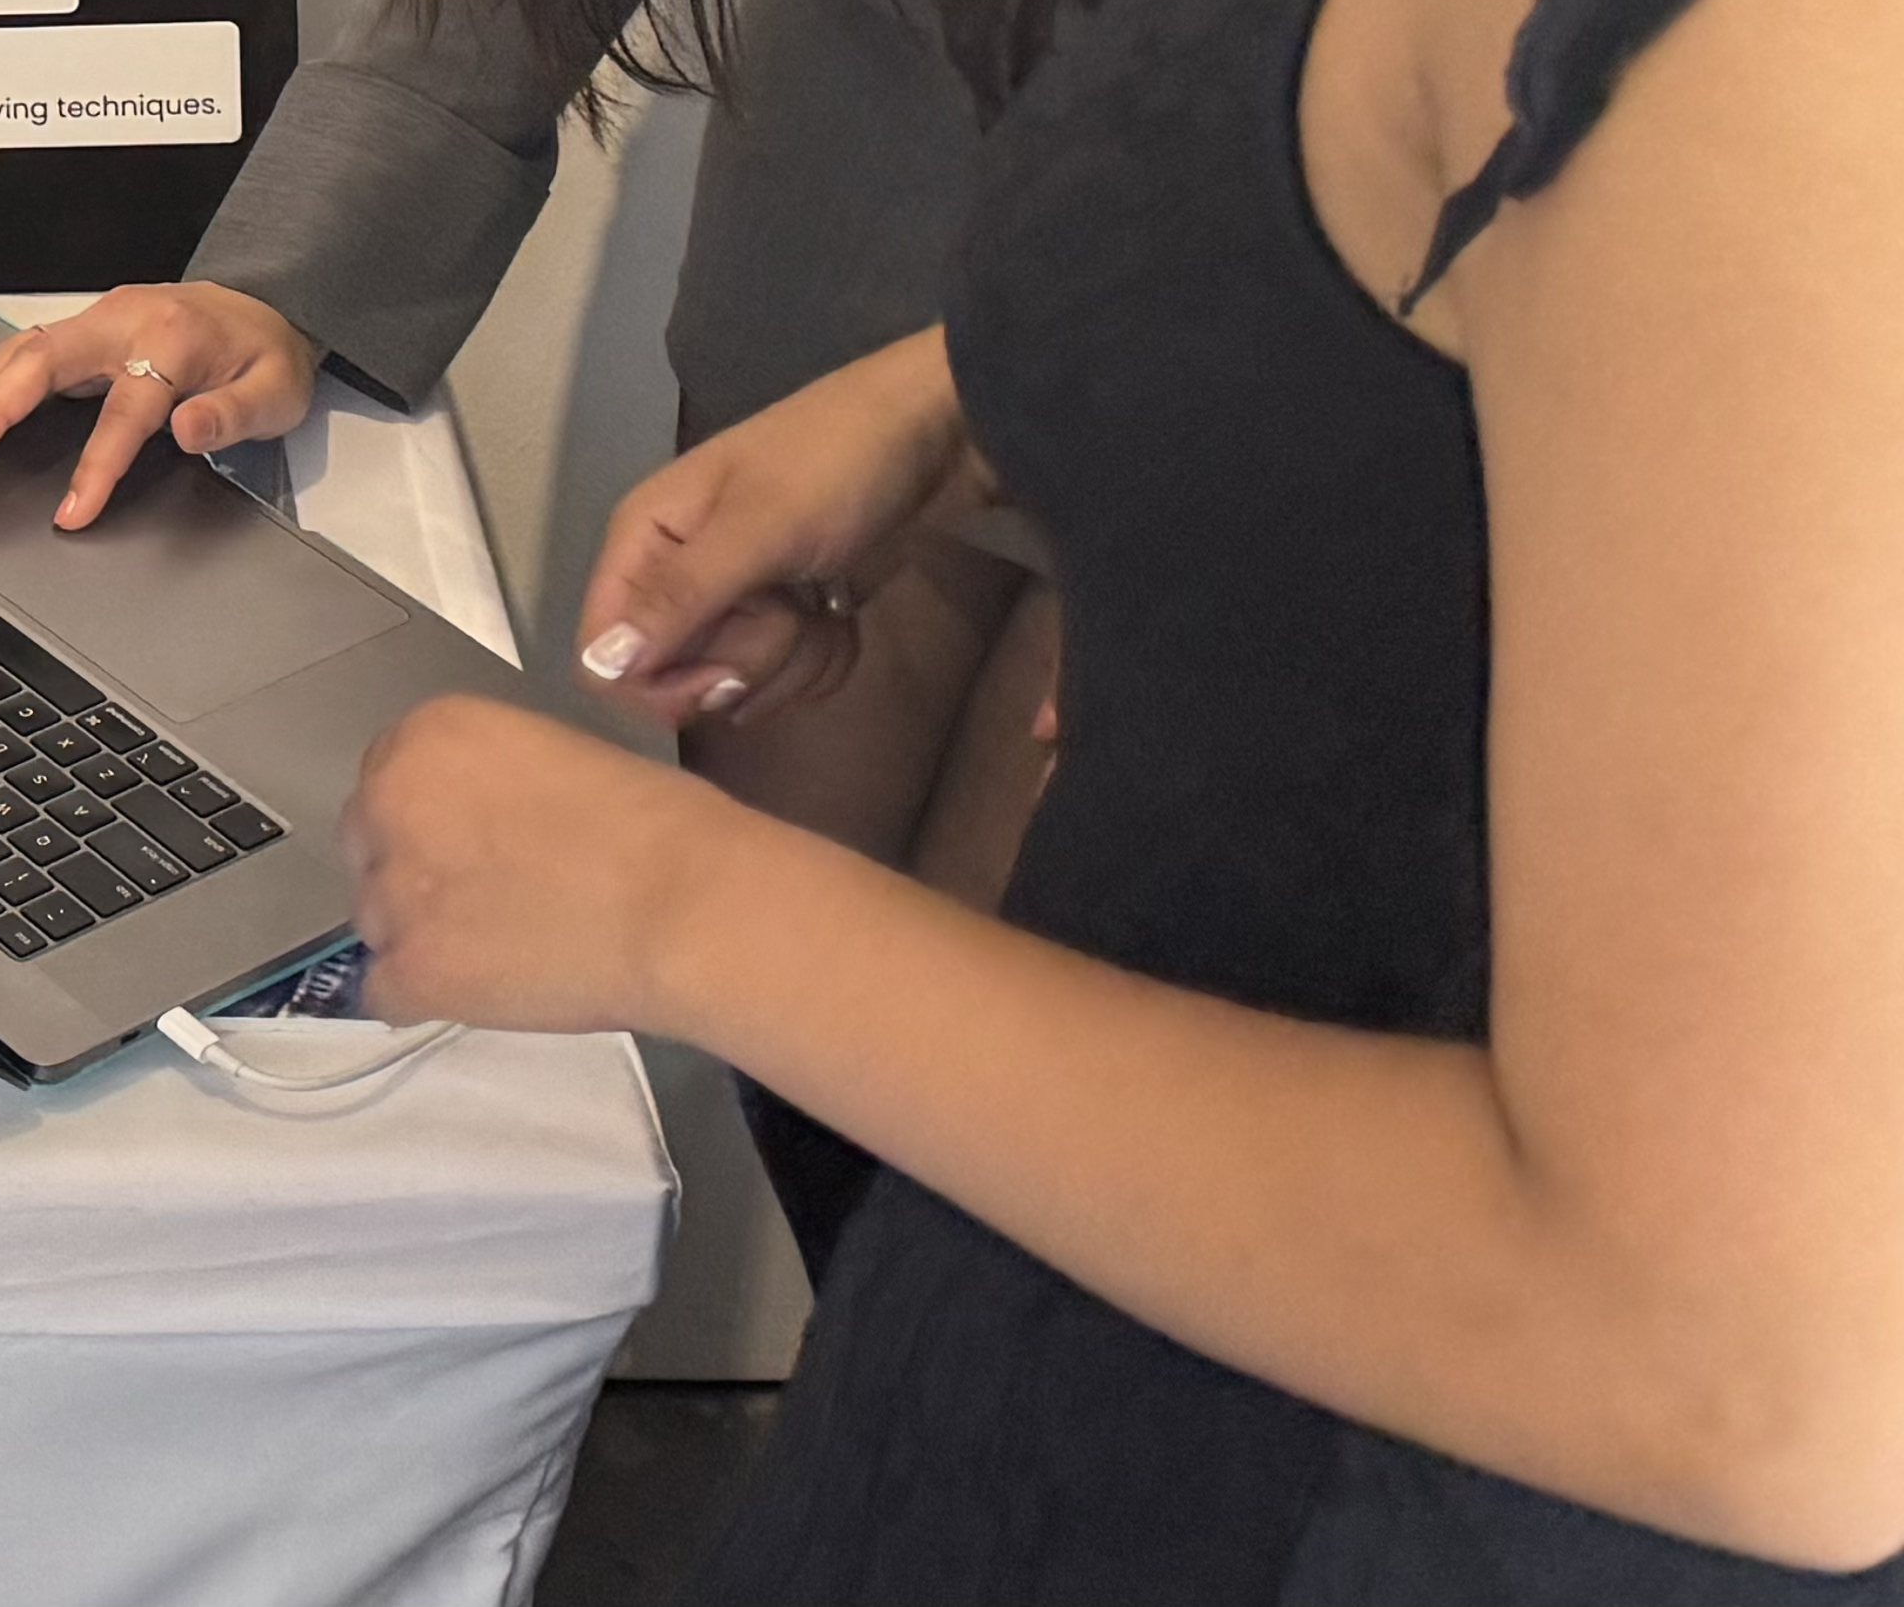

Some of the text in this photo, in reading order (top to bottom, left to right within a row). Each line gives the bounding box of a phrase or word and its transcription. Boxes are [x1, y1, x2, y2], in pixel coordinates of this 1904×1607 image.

[58, 94, 221, 122] techniques.
[18, 707, 34, 718] C
[57, 738, 74, 748] X
[32, 775, 48, 784] S
[99, 769, 115, 779] Z
[74, 805, 89, 816] A
[36, 835, 51, 846] Q
